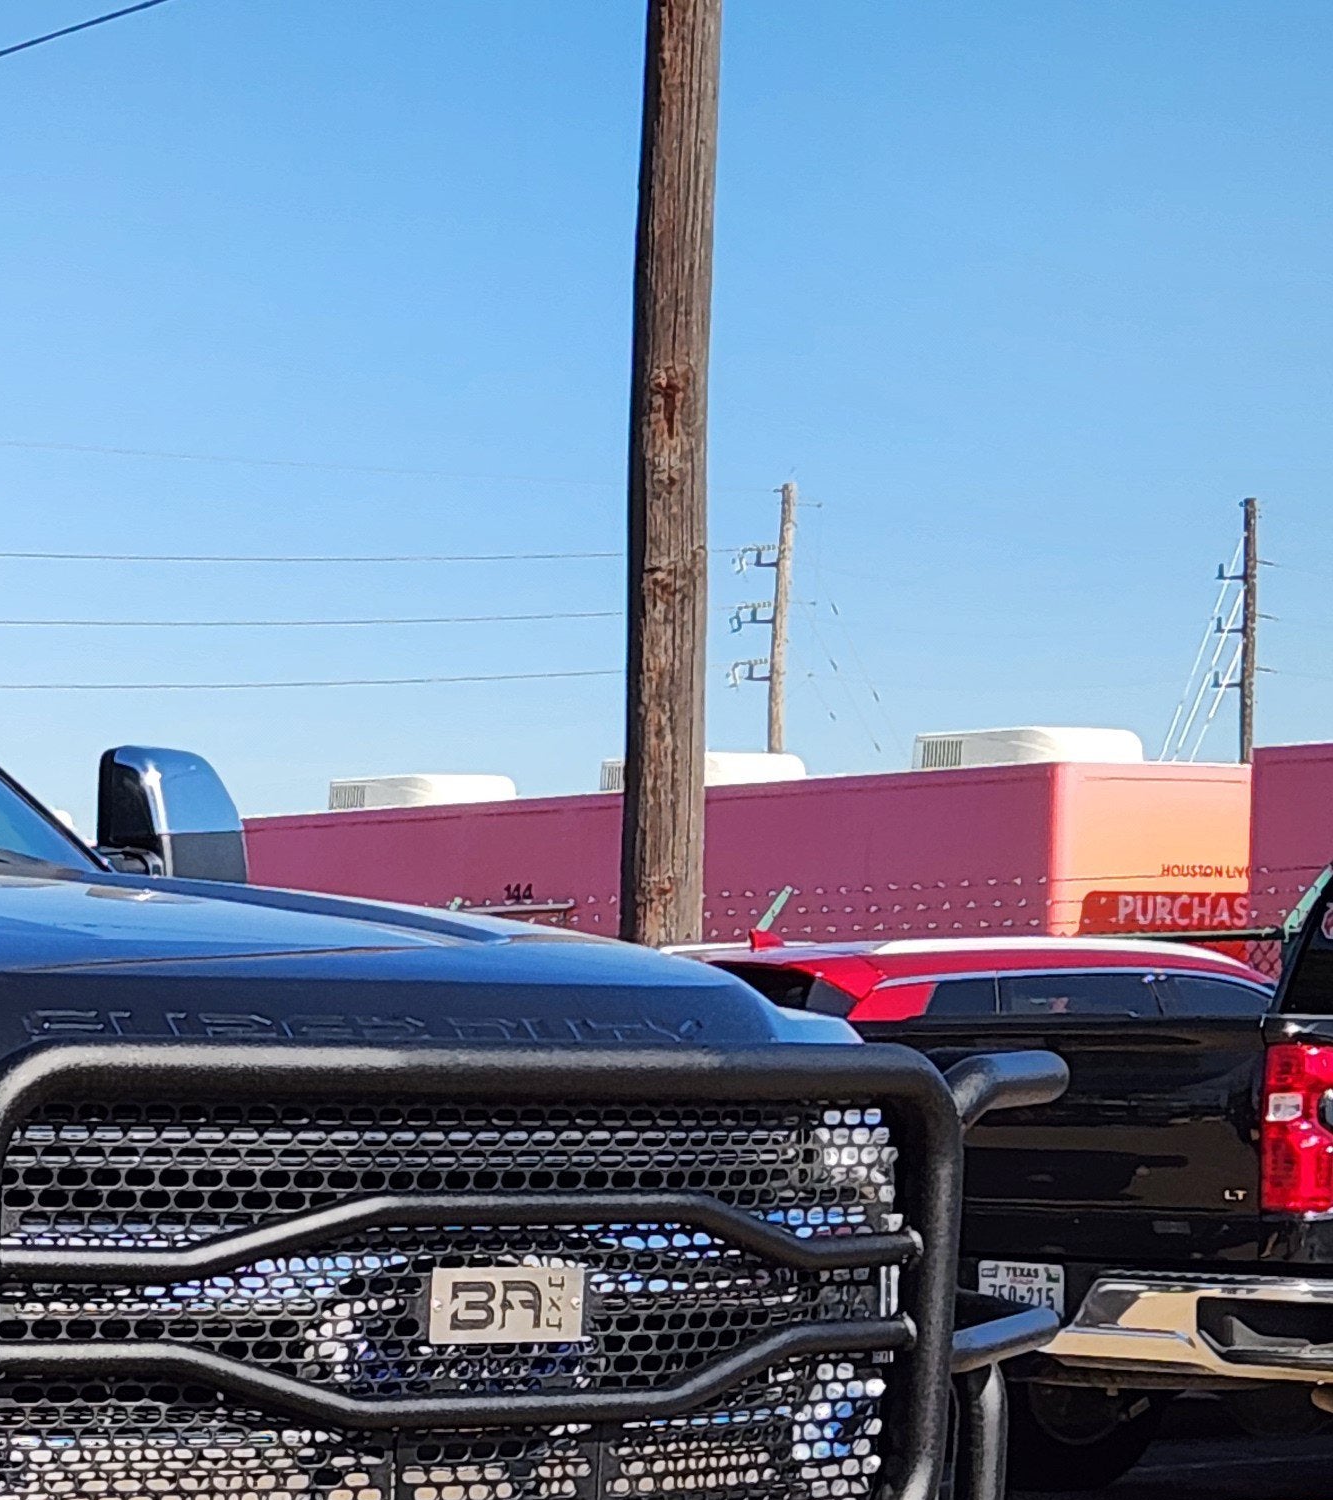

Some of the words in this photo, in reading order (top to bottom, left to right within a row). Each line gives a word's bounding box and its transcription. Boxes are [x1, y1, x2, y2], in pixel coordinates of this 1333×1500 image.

[1161, 864, 1223, 878] HOUSTON
[1117, 893, 1249, 926] PURCHAS
[1224, 1189, 1248, 1201] LT
[1004, 1266, 1040, 1279] TEXAS
